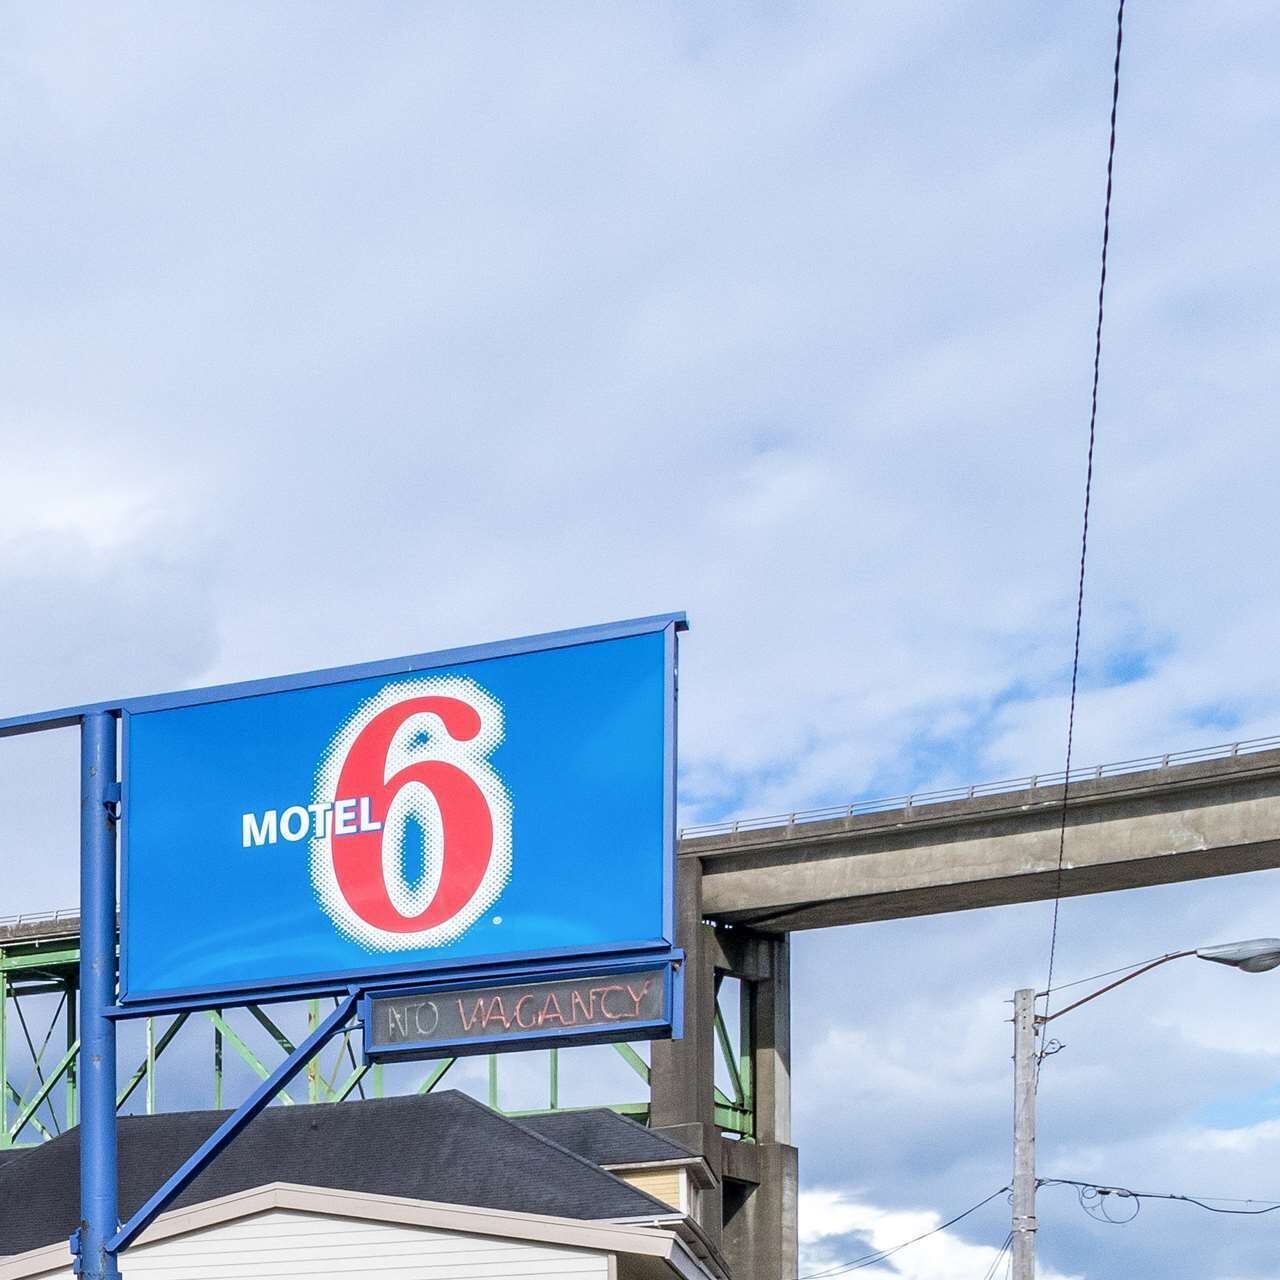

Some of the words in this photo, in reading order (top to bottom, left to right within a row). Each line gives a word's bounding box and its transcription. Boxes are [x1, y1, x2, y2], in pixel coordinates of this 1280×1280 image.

[242, 797, 382, 848] MOTEL
[331, 696, 494, 933] 6
[388, 1001, 439, 1037] NO
[457, 979, 654, 1032] VACANCY
